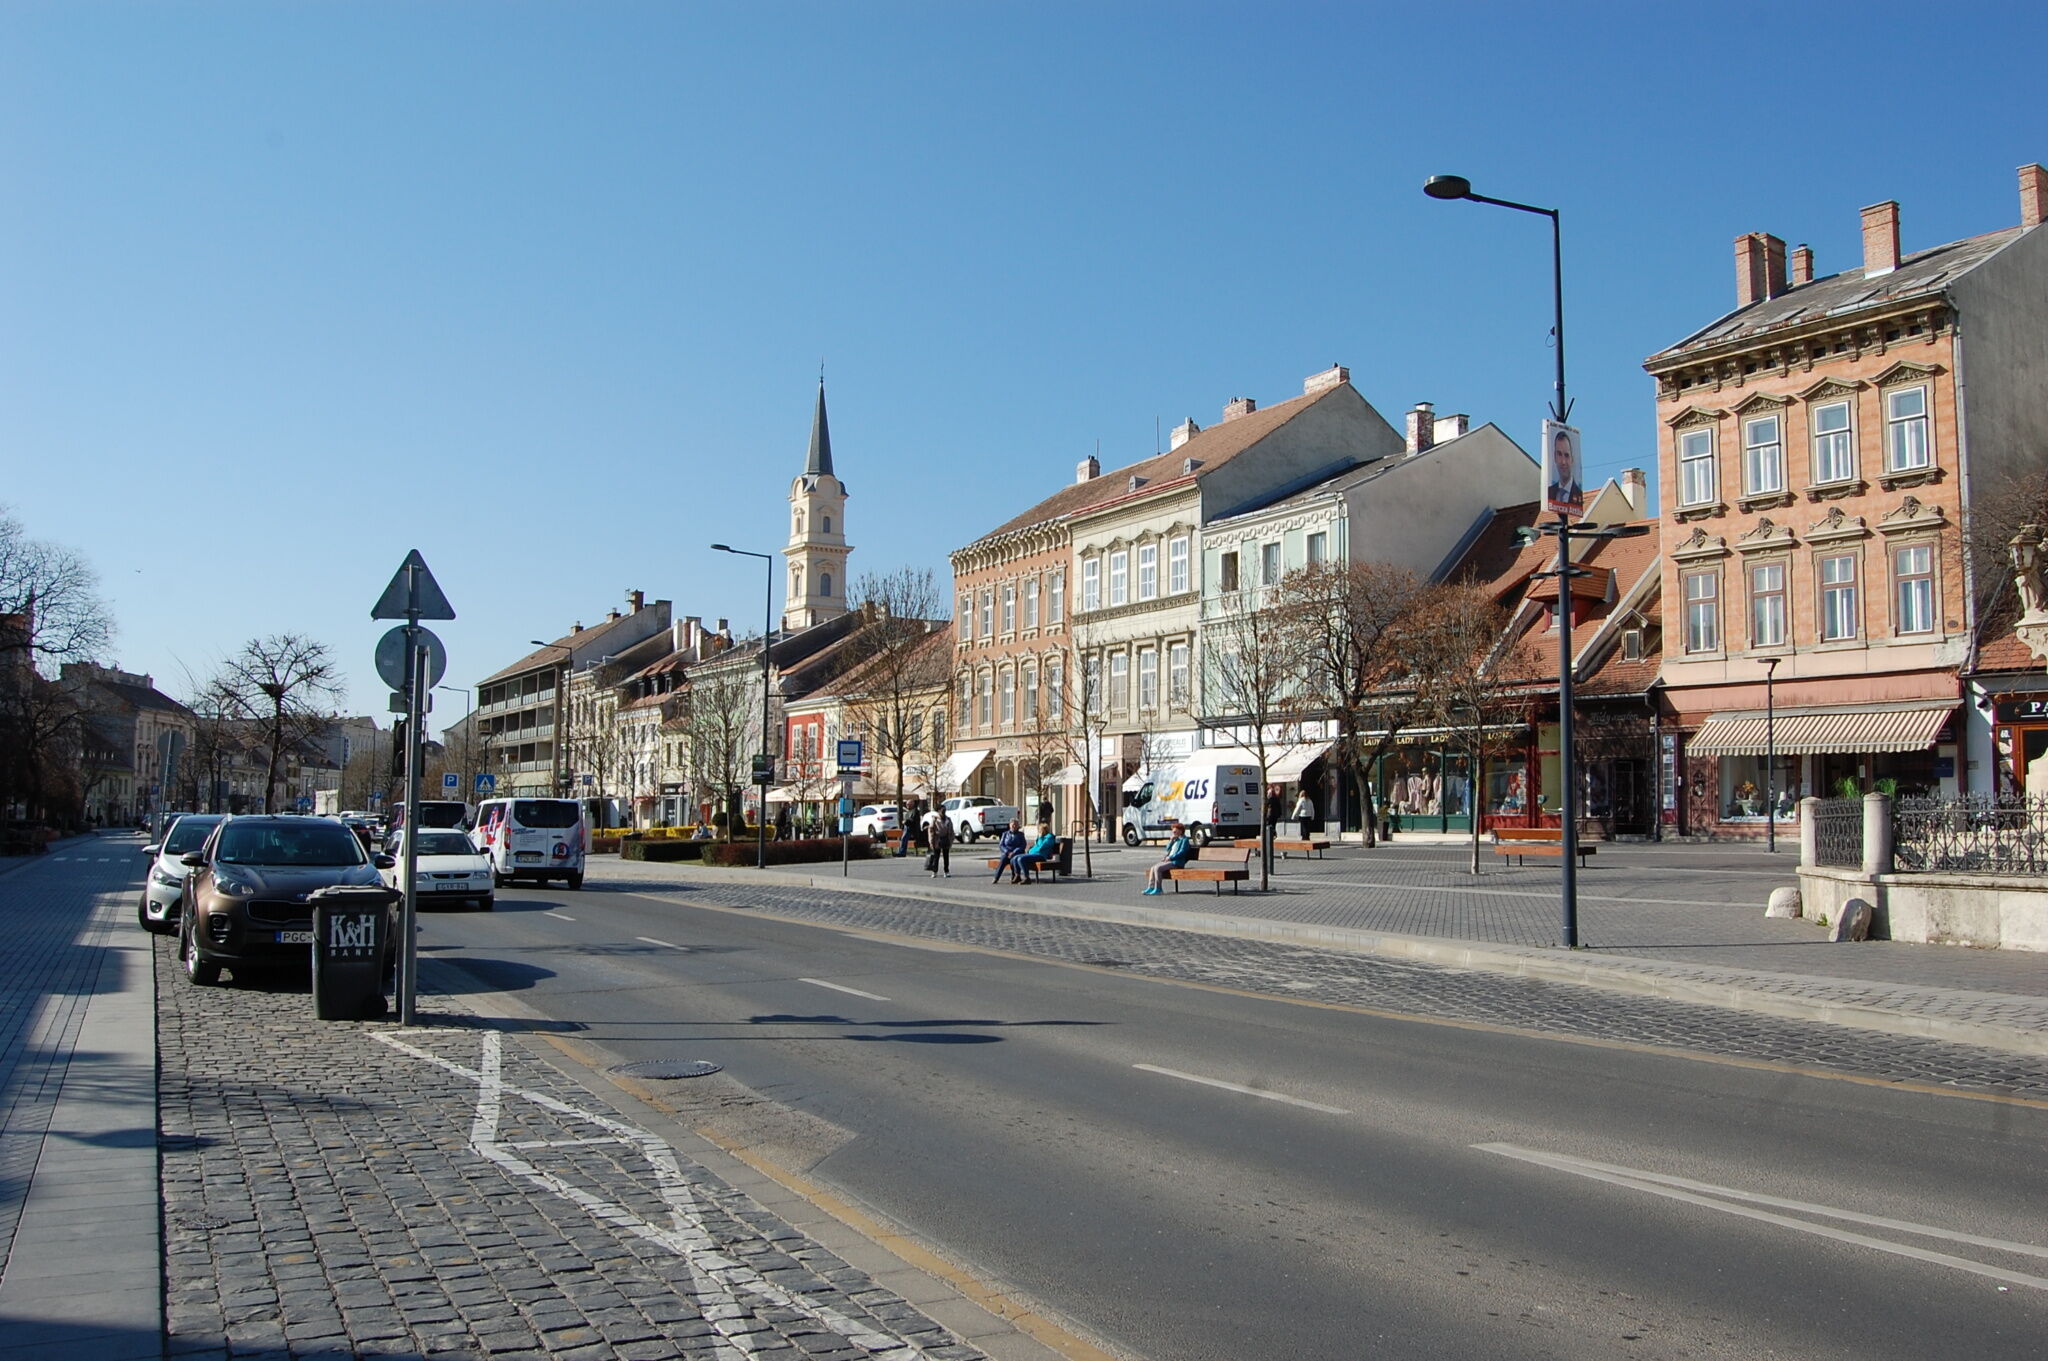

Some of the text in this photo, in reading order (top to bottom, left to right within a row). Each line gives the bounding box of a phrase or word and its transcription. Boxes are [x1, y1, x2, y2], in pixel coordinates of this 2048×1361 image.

[1396, 735, 1415, 745] LADY
[1242, 767, 1253, 776] GLS
[1184, 779, 1209, 800] GLS
[329, 914, 376, 948] K&H
[283, 932, 312, 943] PGC-
[330, 948, 374, 957] BANK
